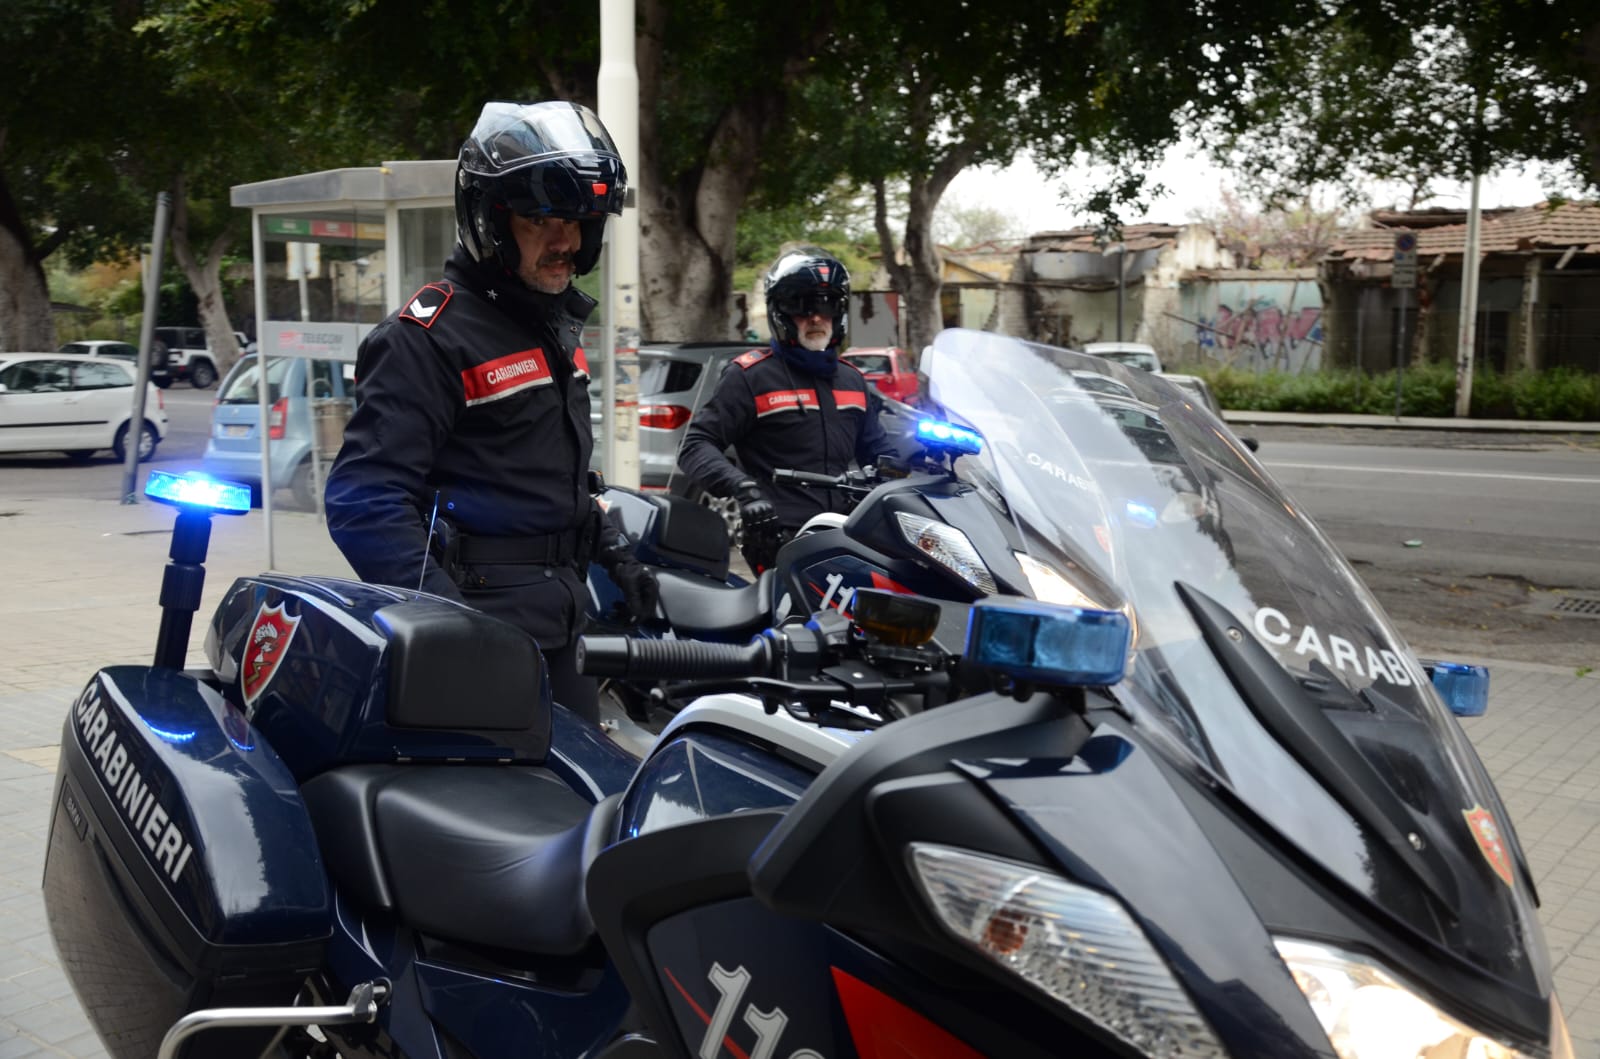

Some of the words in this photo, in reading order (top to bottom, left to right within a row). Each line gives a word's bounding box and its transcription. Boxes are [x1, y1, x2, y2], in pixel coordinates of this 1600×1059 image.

[486, 358, 539, 385] CARABINIERI
[76, 681, 193, 883] CARABINIERI
[698, 961, 826, 1059] 11
